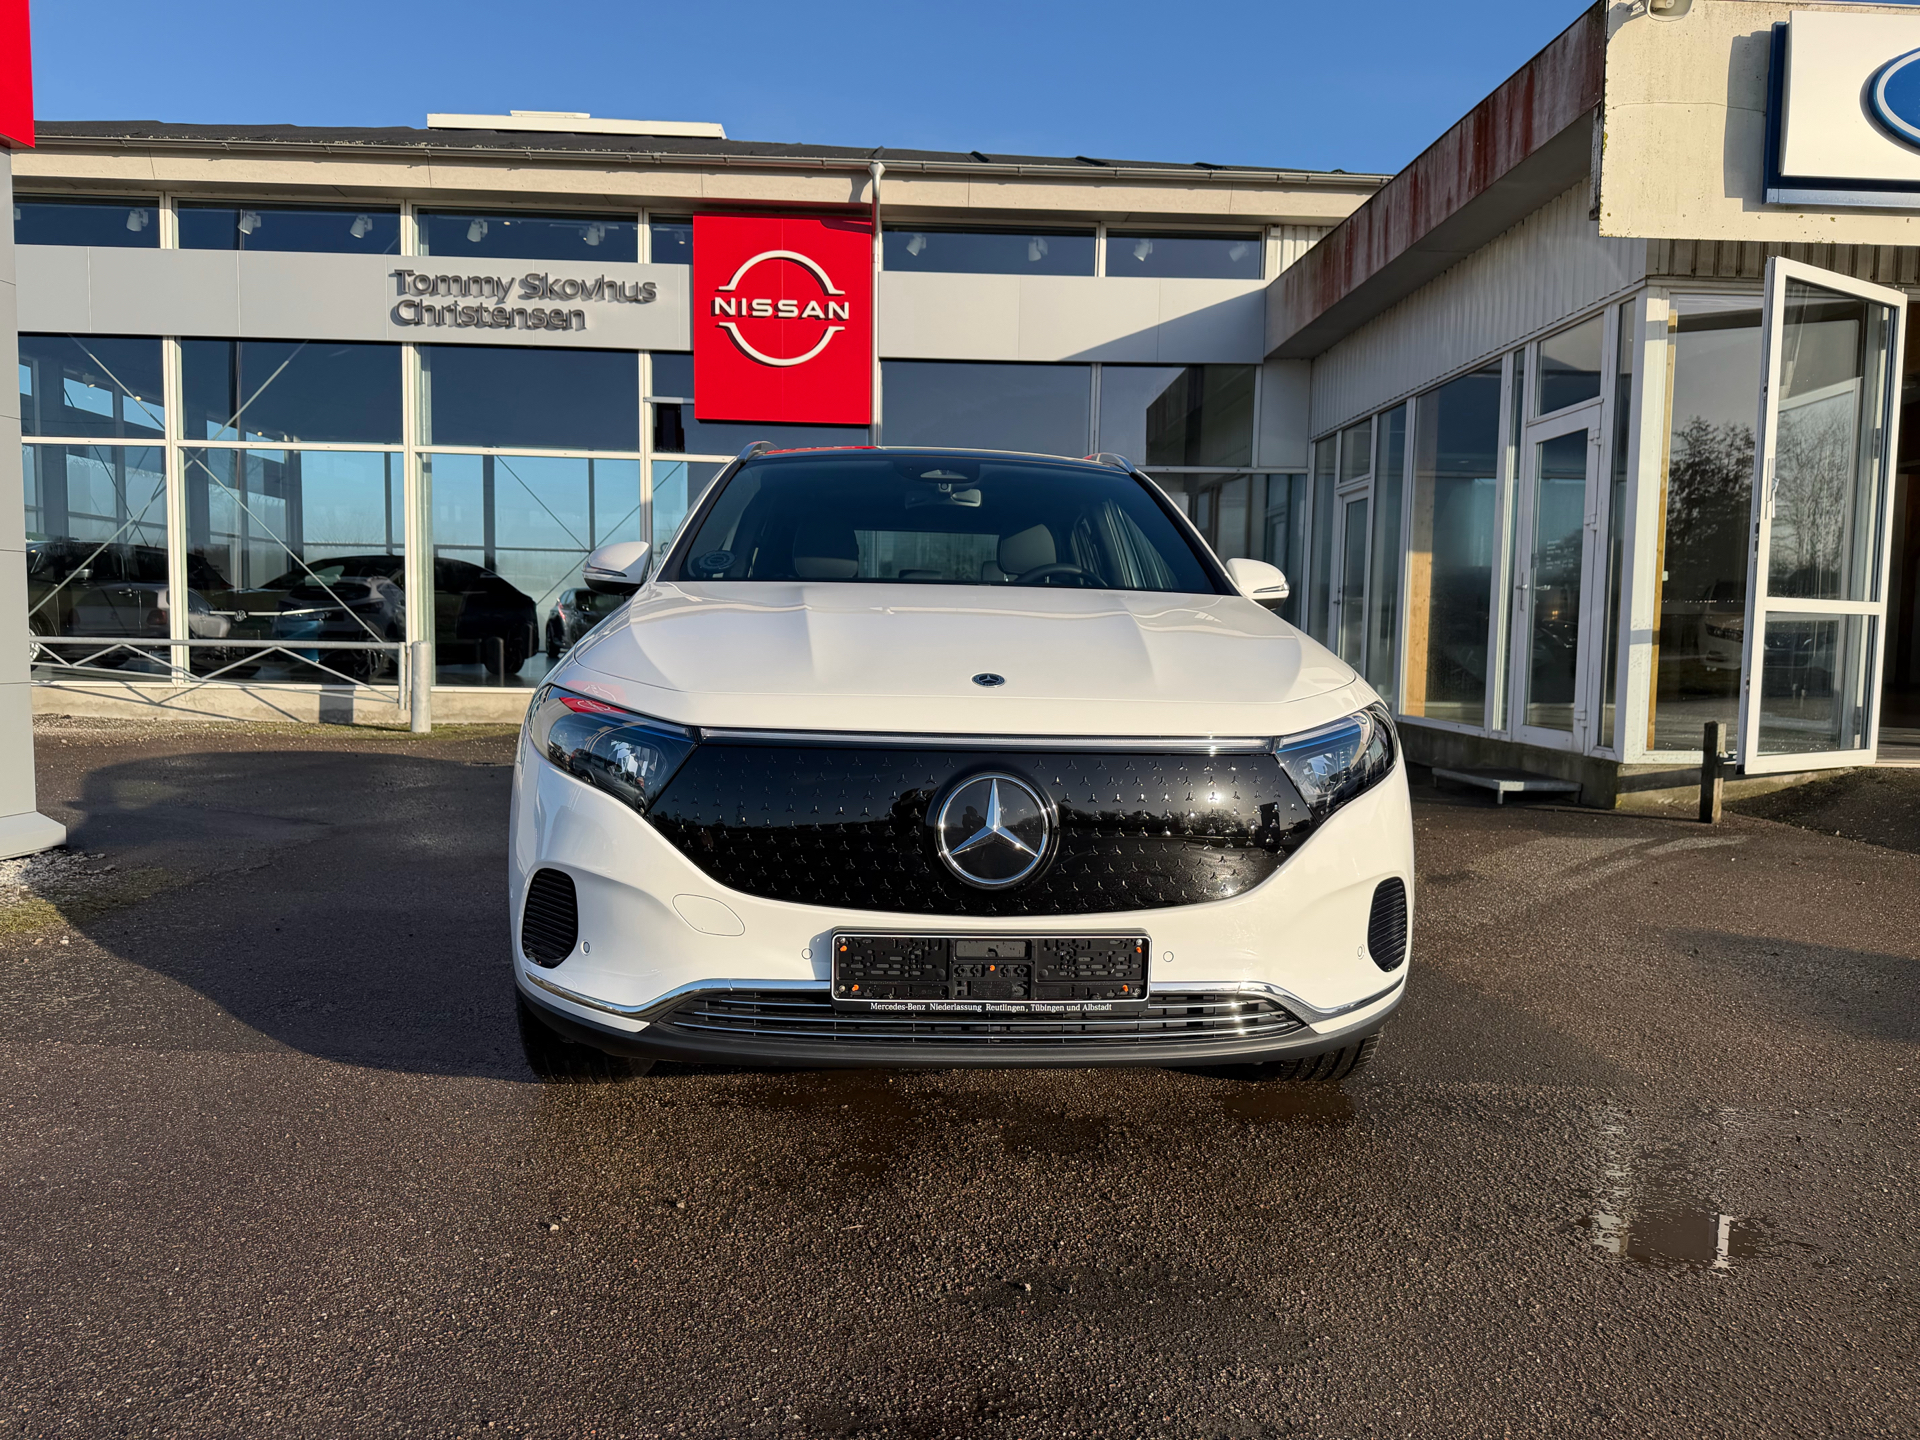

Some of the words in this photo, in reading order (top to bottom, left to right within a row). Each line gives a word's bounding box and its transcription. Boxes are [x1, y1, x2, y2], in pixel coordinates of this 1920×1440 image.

[394, 269, 515, 299] Tommy
[523, 272, 657, 301] Skovhus
[396, 299, 586, 329] Christensen
[714, 296, 850, 320] NISSAN
[870, 1002, 926, 1011] Mercedes-Benz
[929, 1002, 983, 1013] Niederlassung
[985, 1003, 1029, 1013] Reutlingen,
[1030, 1003, 1064, 1013] Tübingen
[1066, 1003, 1081, 1011] und
[1082, 1003, 1113, 1011] Albstadt
